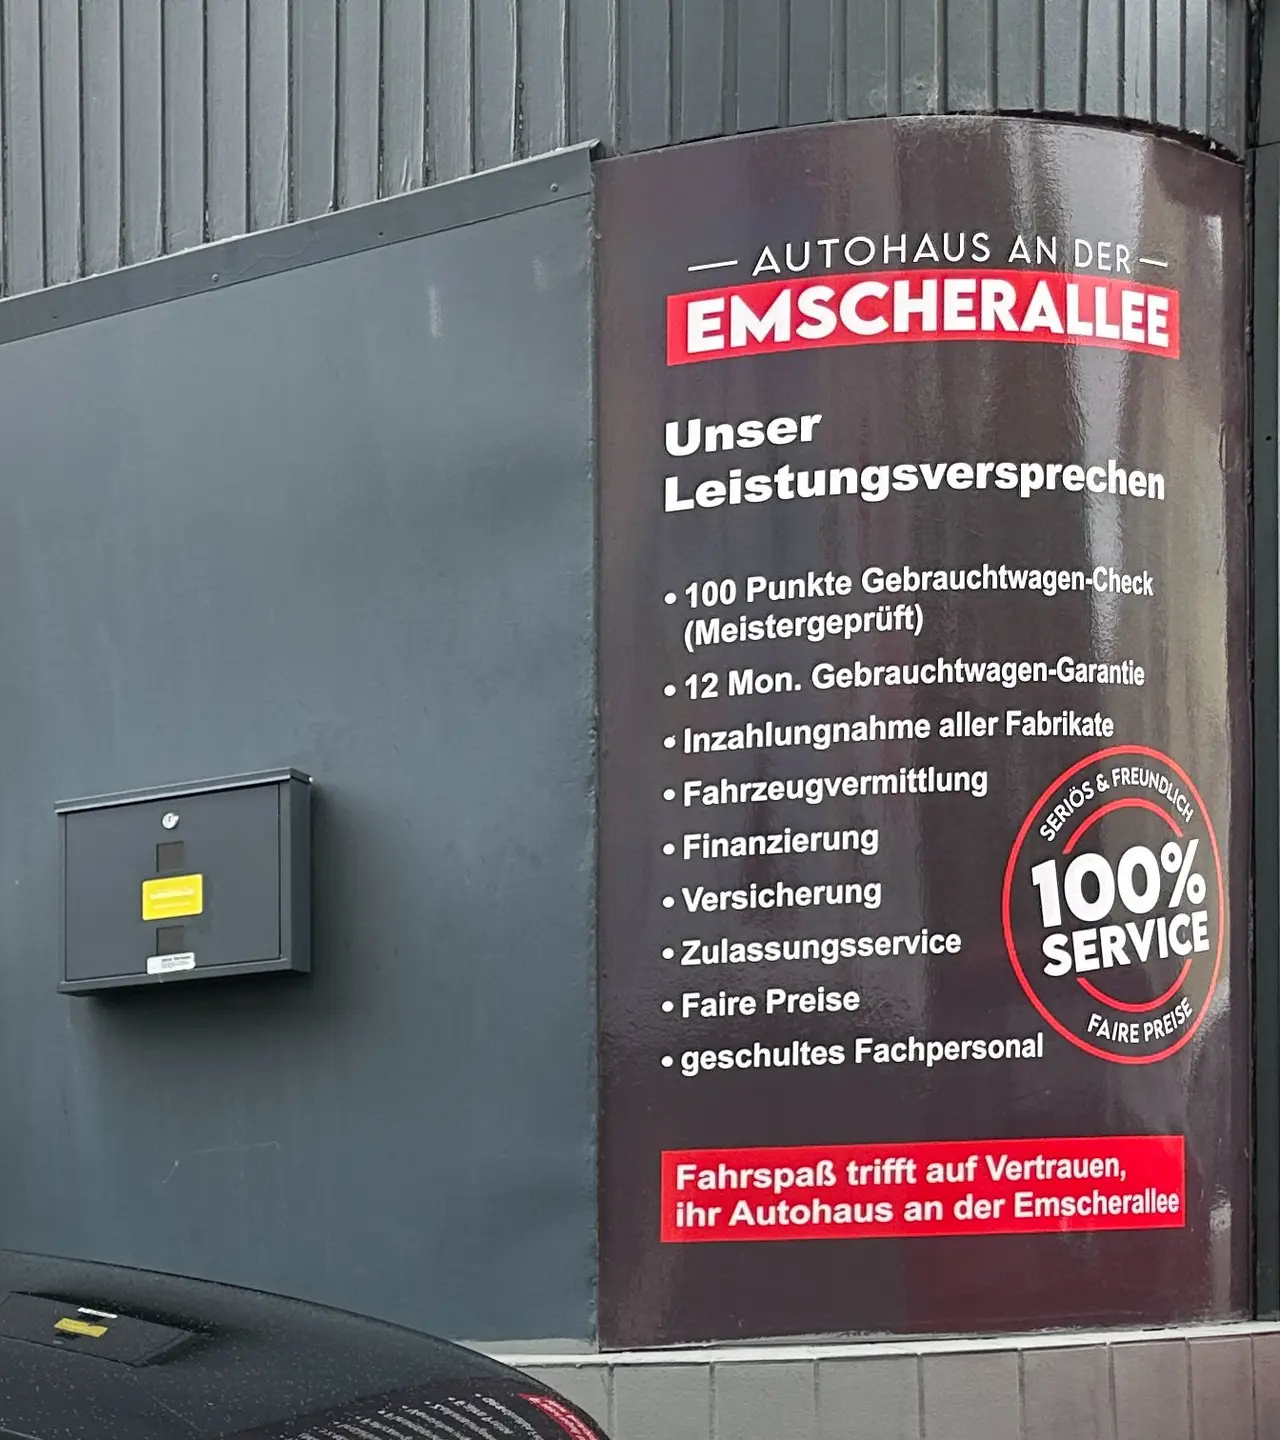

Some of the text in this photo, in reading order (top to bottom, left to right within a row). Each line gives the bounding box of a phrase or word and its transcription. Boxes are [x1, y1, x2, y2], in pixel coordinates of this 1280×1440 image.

[752, 232, 1132, 277] AUTOHAUS AN DER
[687, 278, 1169, 354] EMSCHERALLEE
[665, 412, 823, 457] Unser
[665, 460, 1165, 513] Leistungsversprechen
[684, 564, 1155, 609] 100 Punkte Gebrauchtwagen-Check
[684, 601, 925, 652] (Meistergeprüft)
[684, 656, 1145, 700] 12 Mon. Gebrauchtwagen-Garantie
[684, 710, 1114, 754] Inzahlungnahme aller Fabrikate
[683, 766, 988, 807] Fahrzeugvermittlung
[1040, 768, 1194, 842] SERIÖS & FREUNDLICH
[683, 827, 879, 860] Finanzierung
[681, 880, 882, 913] Versicherung
[1031, 838, 1206, 928] 100%
[681, 929, 962, 966] Zulassungsservice
[1042, 910, 1210, 978] SERVICE
[682, 986, 860, 1018] Faire Preise
[1087, 997, 1193, 1044] FAIRE PREISE
[681, 1032, 1044, 1077] geschultes Fachpersonal
[676, 1153, 1127, 1193] Fahrspaß trifft auf Vertrauen,
[676, 1188, 1179, 1227] ihr Autohaus an der Emscherallee
